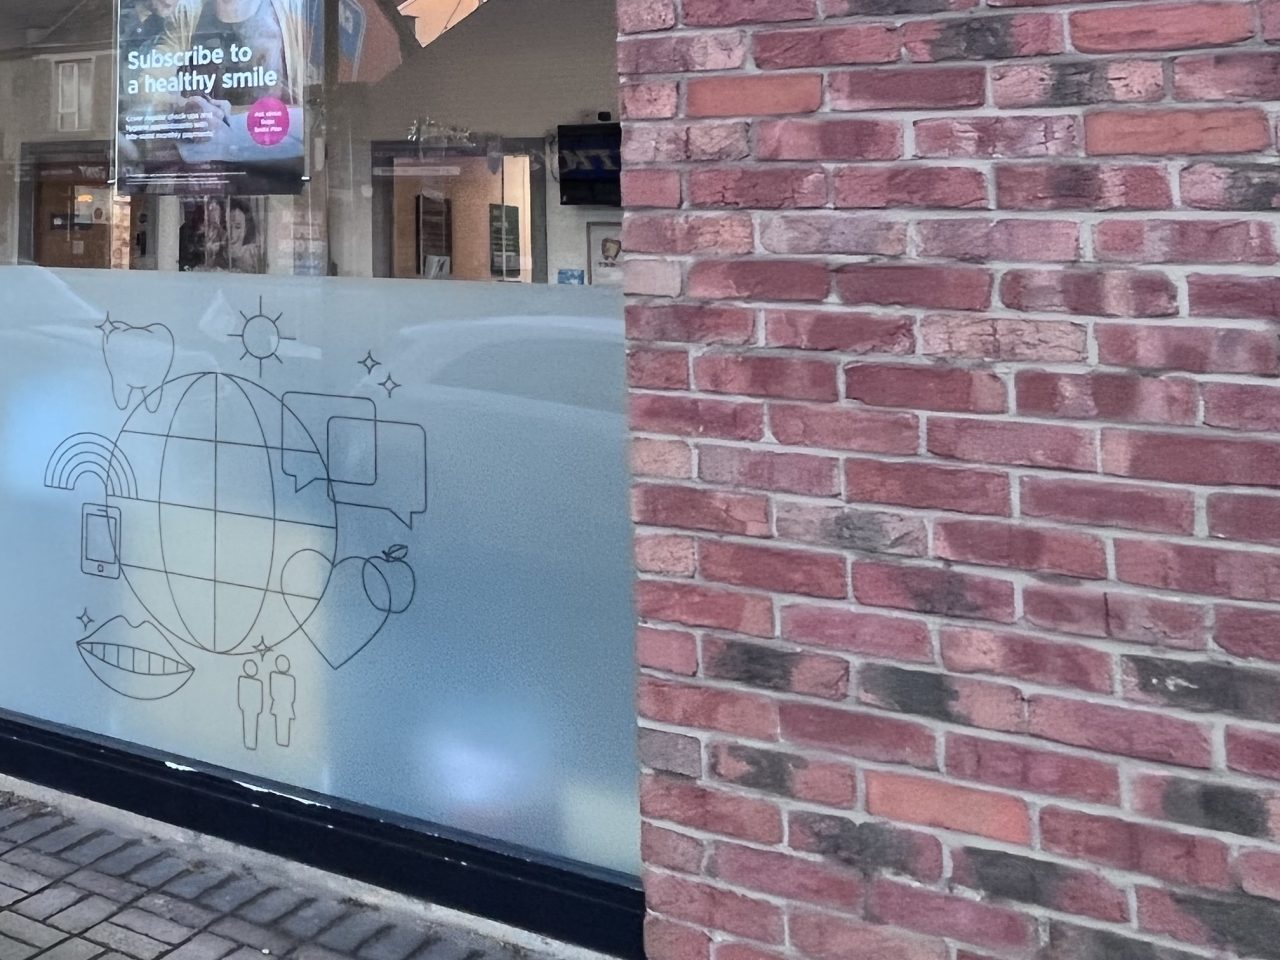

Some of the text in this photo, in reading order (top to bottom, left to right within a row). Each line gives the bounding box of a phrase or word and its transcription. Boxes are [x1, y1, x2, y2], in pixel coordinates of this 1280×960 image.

[127, 44, 252, 69] Subscribe to
[128, 66, 277, 94] a healthy smile
